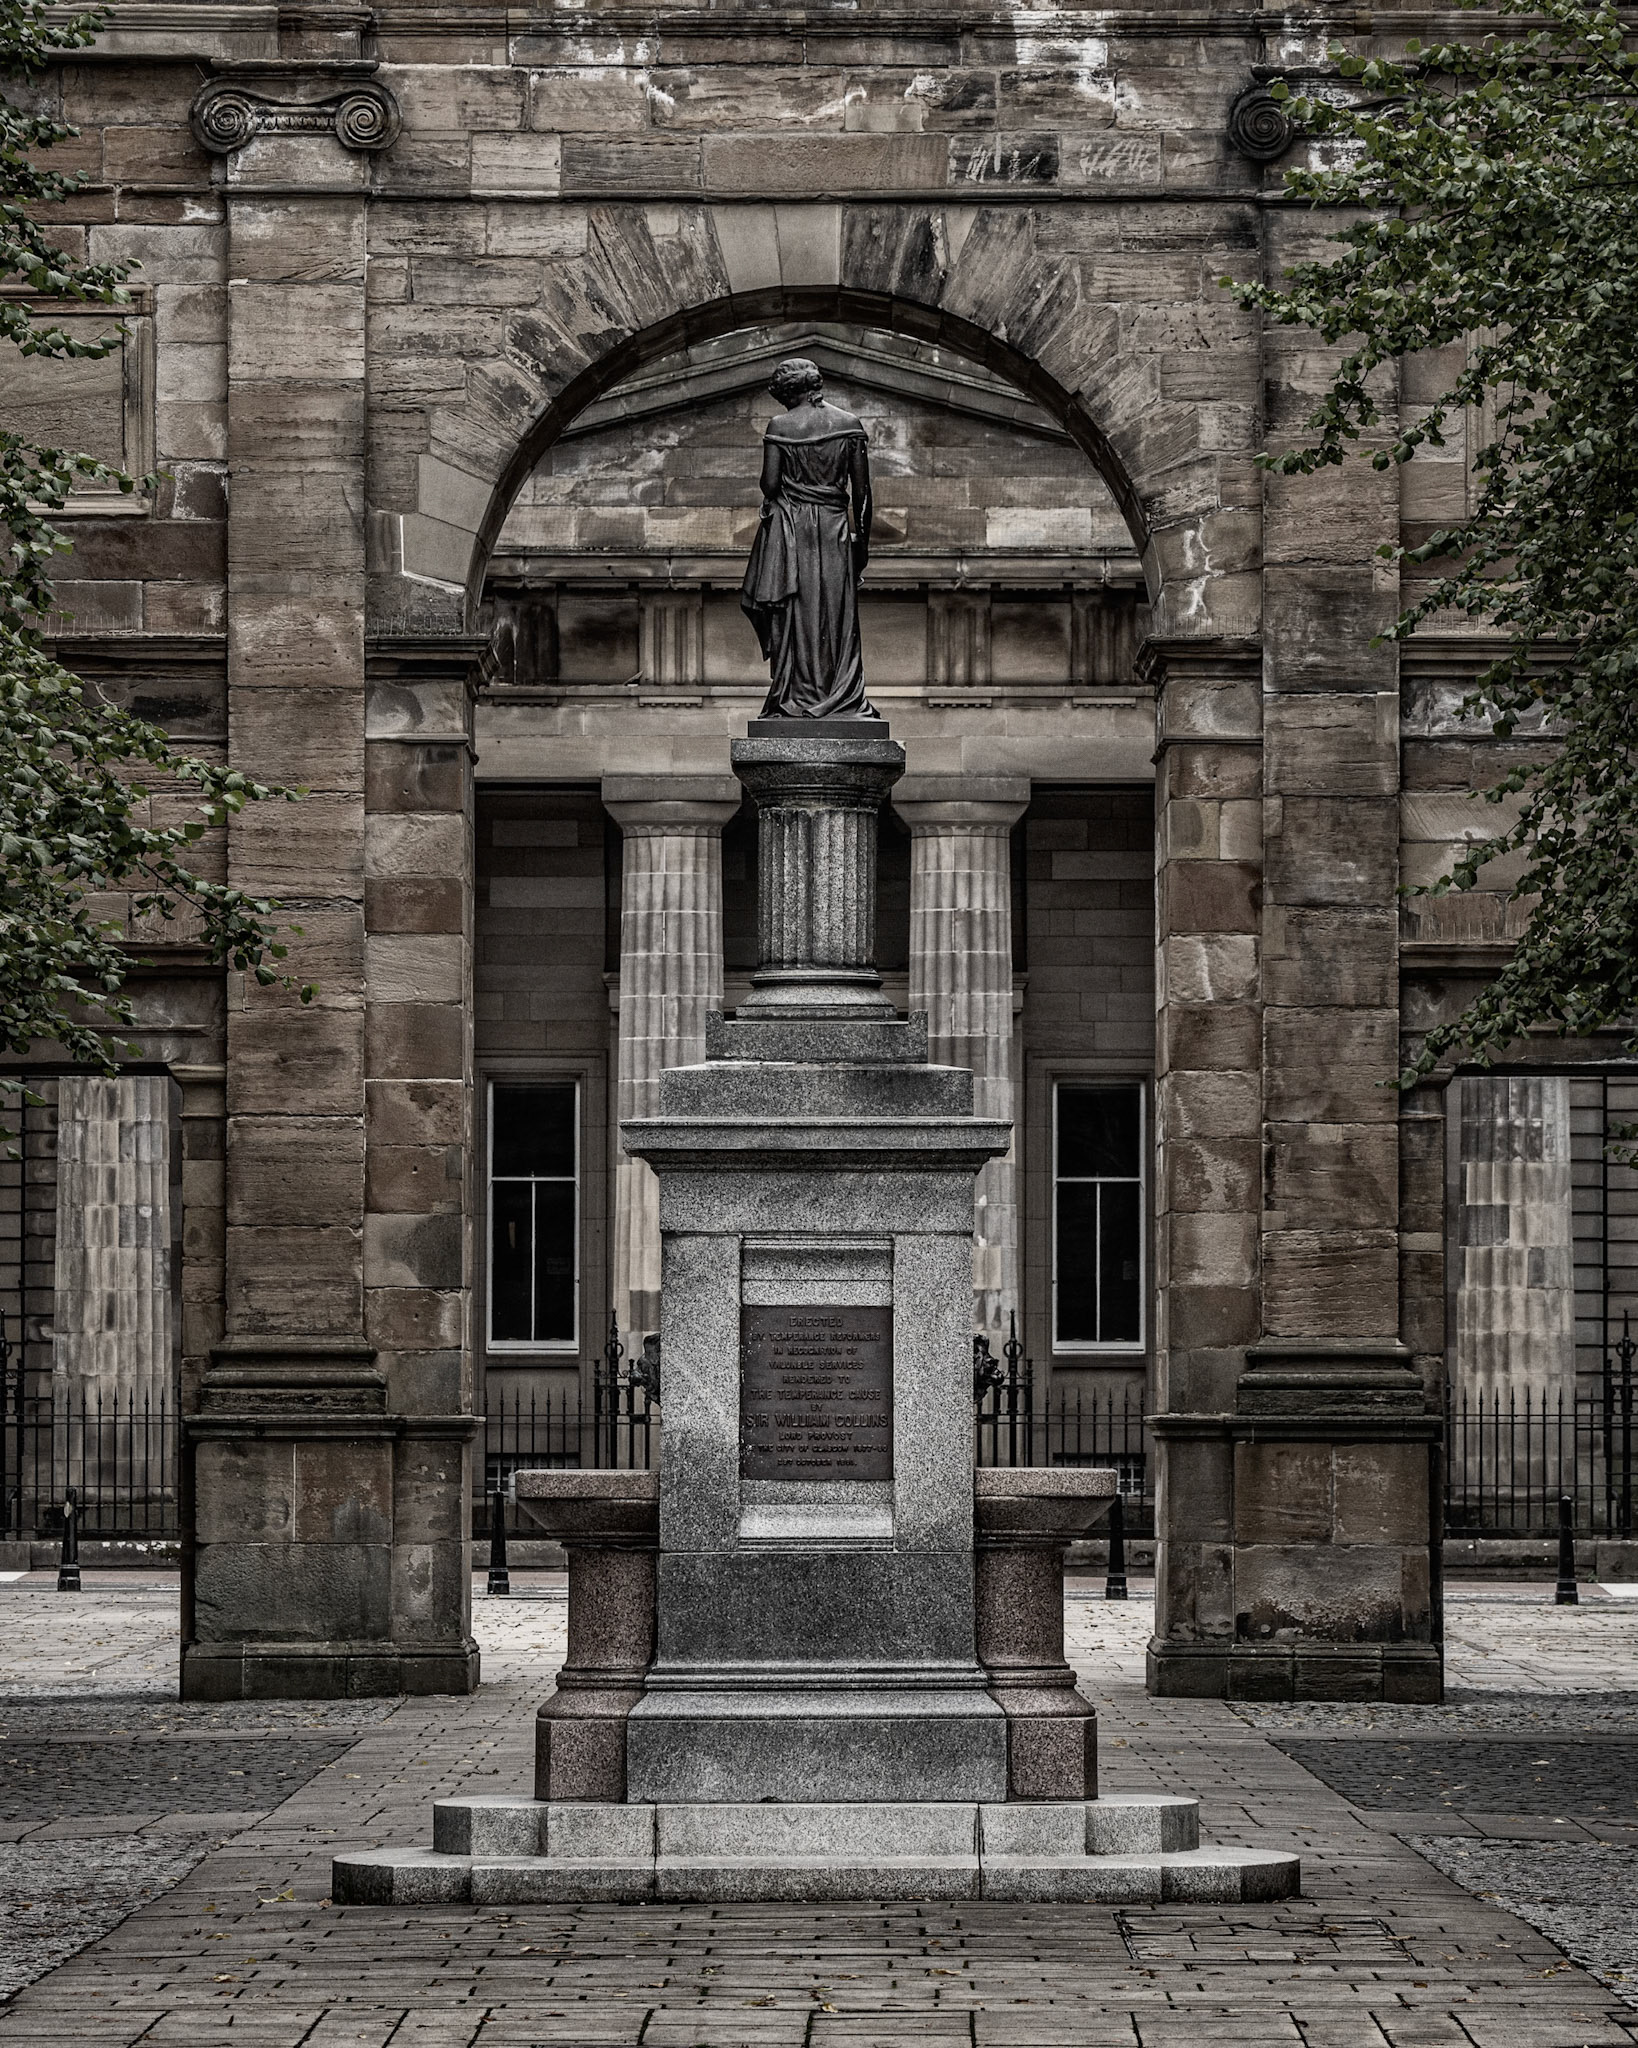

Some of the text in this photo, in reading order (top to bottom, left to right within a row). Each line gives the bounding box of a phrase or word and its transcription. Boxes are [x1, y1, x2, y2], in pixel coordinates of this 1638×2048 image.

[789, 1316, 844, 1328] ERECTED
[769, 1332, 826, 1342] TEMPERANCE
[830, 1332, 881, 1342] REFORMERS
[773, 1346, 859, 1356] IN RECOGNITION OF
[768, 1361, 865, 1370] VALUABLE SERVICES
[782, 1375, 851, 1385] RENDERED TO
[750, 1389, 881, 1401] THE TEMPERANCE CAUSE
[811, 1403, 824, 1412] BY
[745, 1413, 888, 1428] SIR WILLIAM COLLINS
[778, 1431, 853, 1441] LORD PROVOST
[757, 1444, 774, 1452] THE
[776, 1444, 795, 1453] CITY
[798, 1444, 809, 1453] OF
[812, 1444, 849, 1453] GLASGOW
